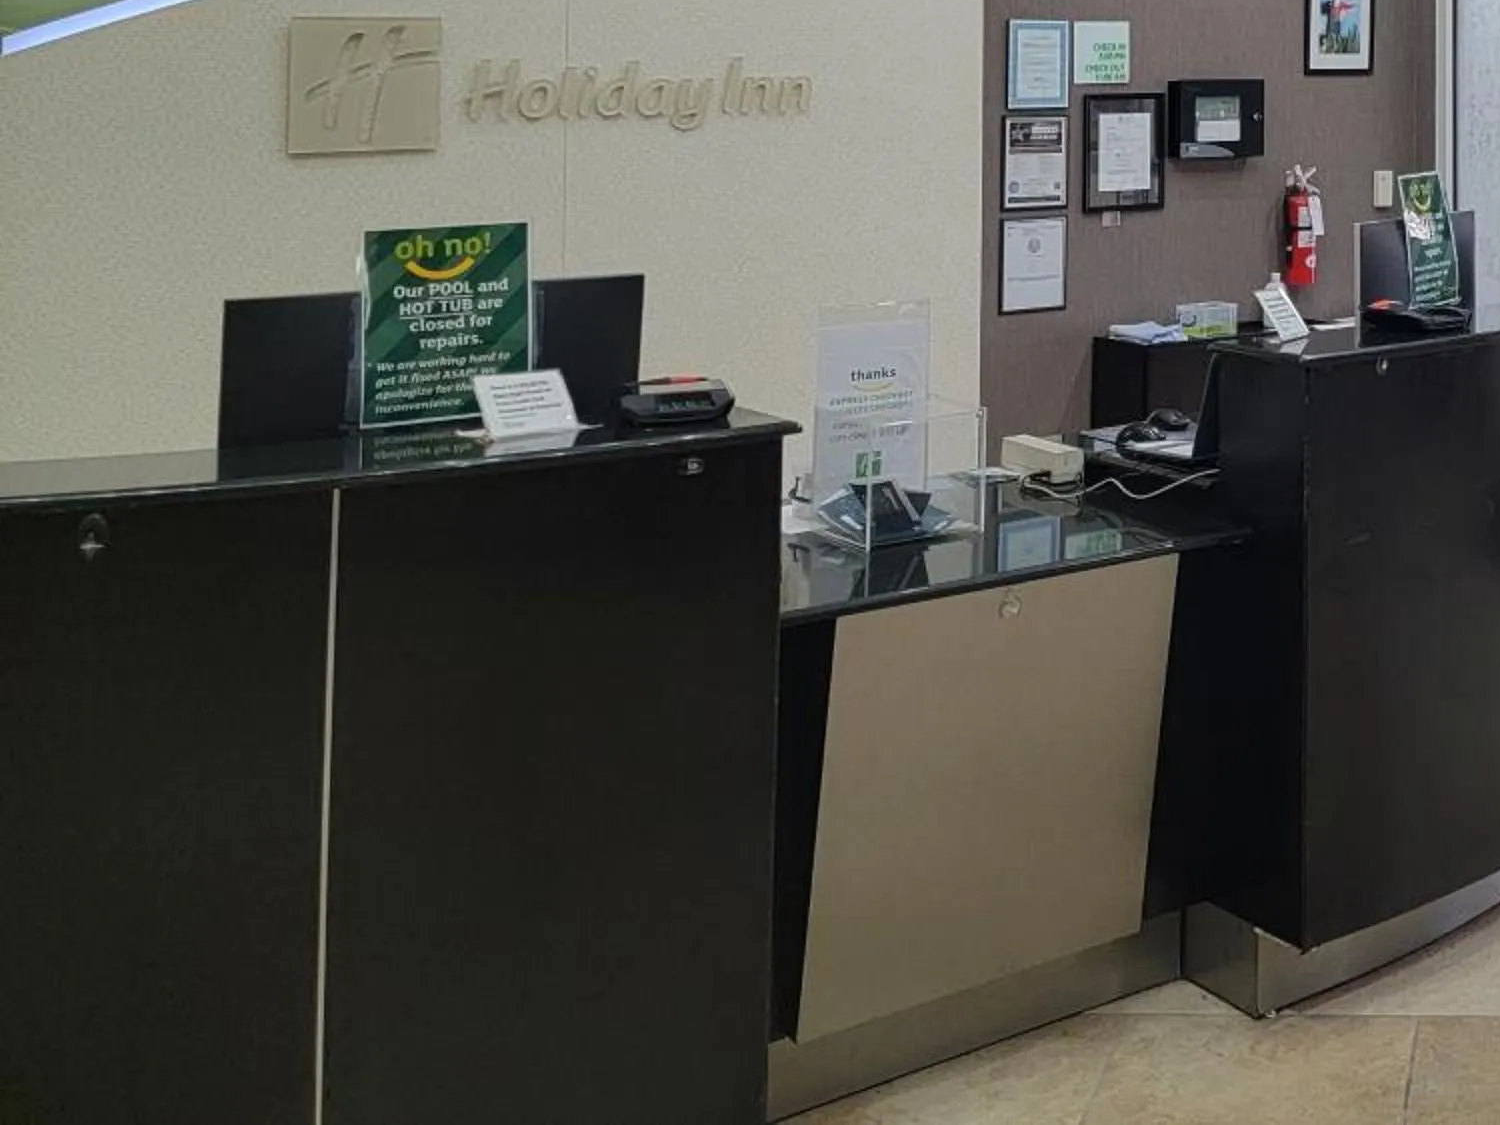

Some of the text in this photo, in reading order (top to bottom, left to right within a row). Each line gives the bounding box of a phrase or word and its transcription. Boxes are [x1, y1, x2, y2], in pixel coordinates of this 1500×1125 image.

[462, 55, 813, 132] Holiday Inn
[394, 232, 492, 260] oh no!
[393, 277, 510, 299] Our POOL and
[399, 297, 504, 317] HOT TUB are
[409, 314, 494, 333] closed for
[419, 333, 484, 351] repairs.
[377, 350, 511, 372] We are working hard to
[375, 375, 396, 389] get
[398, 373, 409, 385] it
[410, 370, 441, 384] fixed
[851, 366, 897, 382] thanks
[375, 385, 434, 401] apologize
[436, 383, 453, 394] for
[375, 398, 465, 415] inconvenience.
